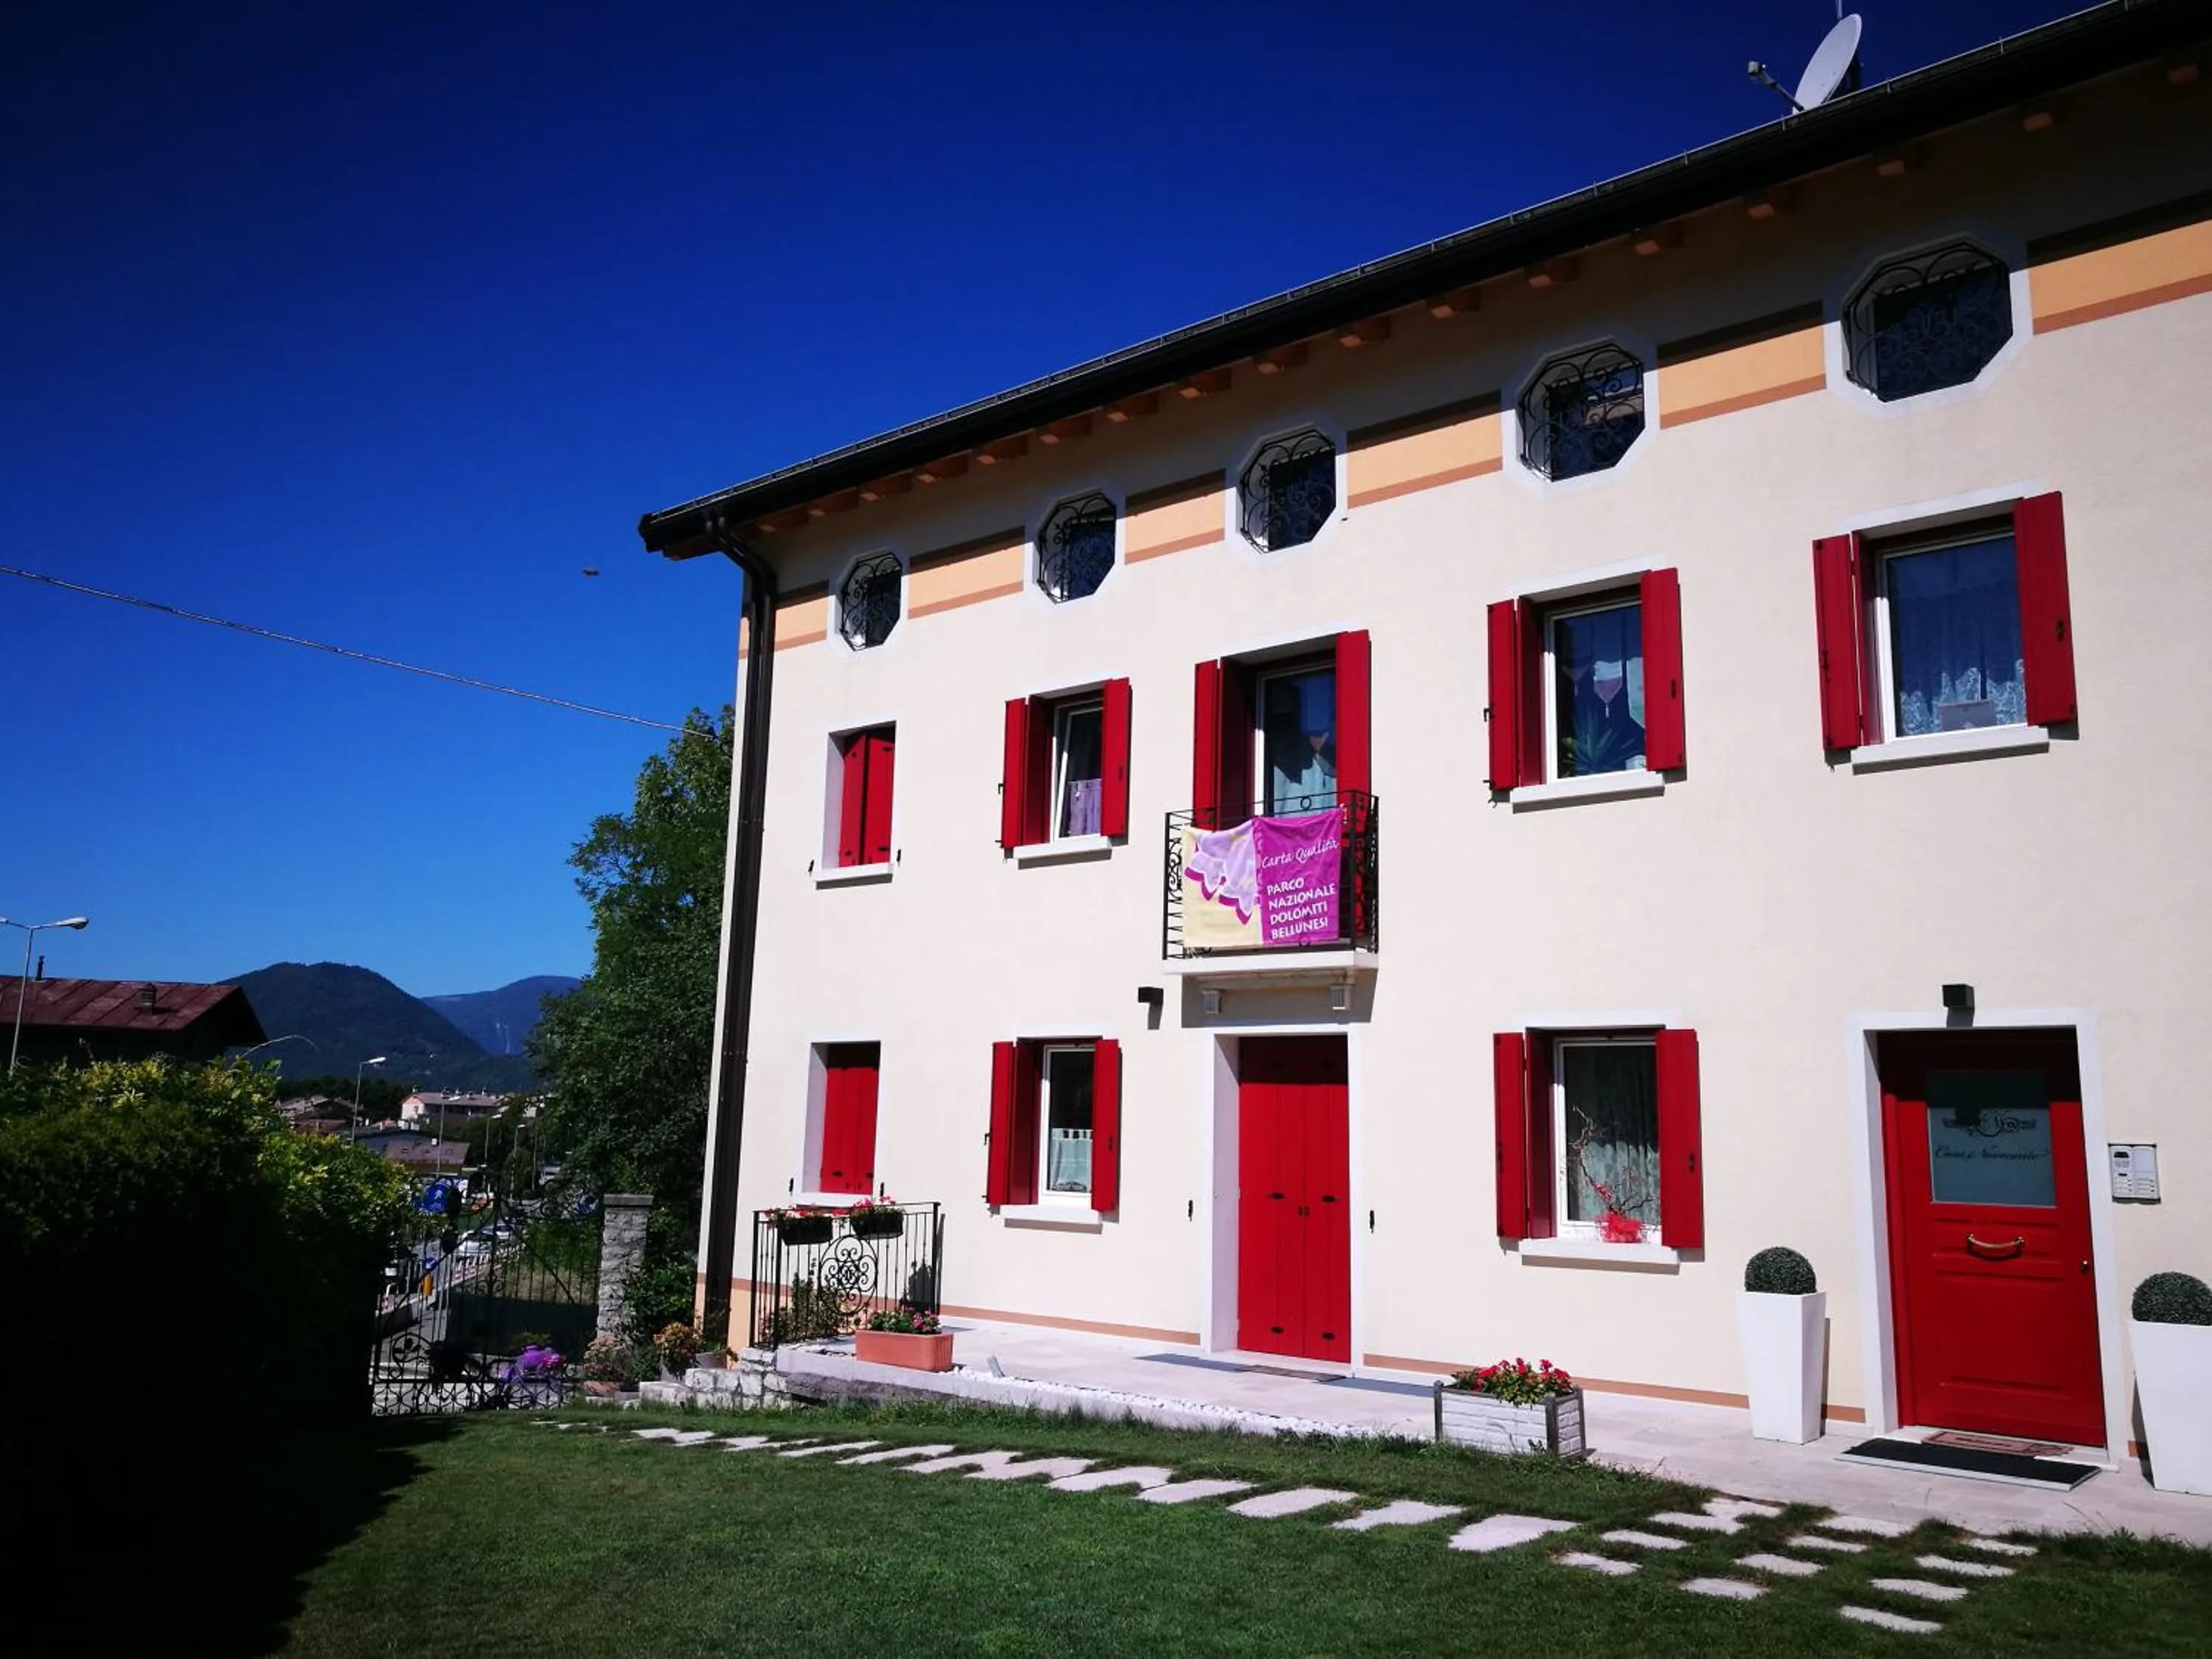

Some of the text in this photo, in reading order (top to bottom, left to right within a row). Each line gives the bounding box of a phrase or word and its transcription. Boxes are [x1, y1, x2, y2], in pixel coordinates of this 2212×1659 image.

[1262, 852, 1293, 868] Carta
[1267, 877, 1304, 896] PARCO
[1268, 883, 1335, 911] NAZIONALE
[1270, 901, 1327, 925] DOLOMITI
[1272, 917, 1327, 939] BELLUNESI
